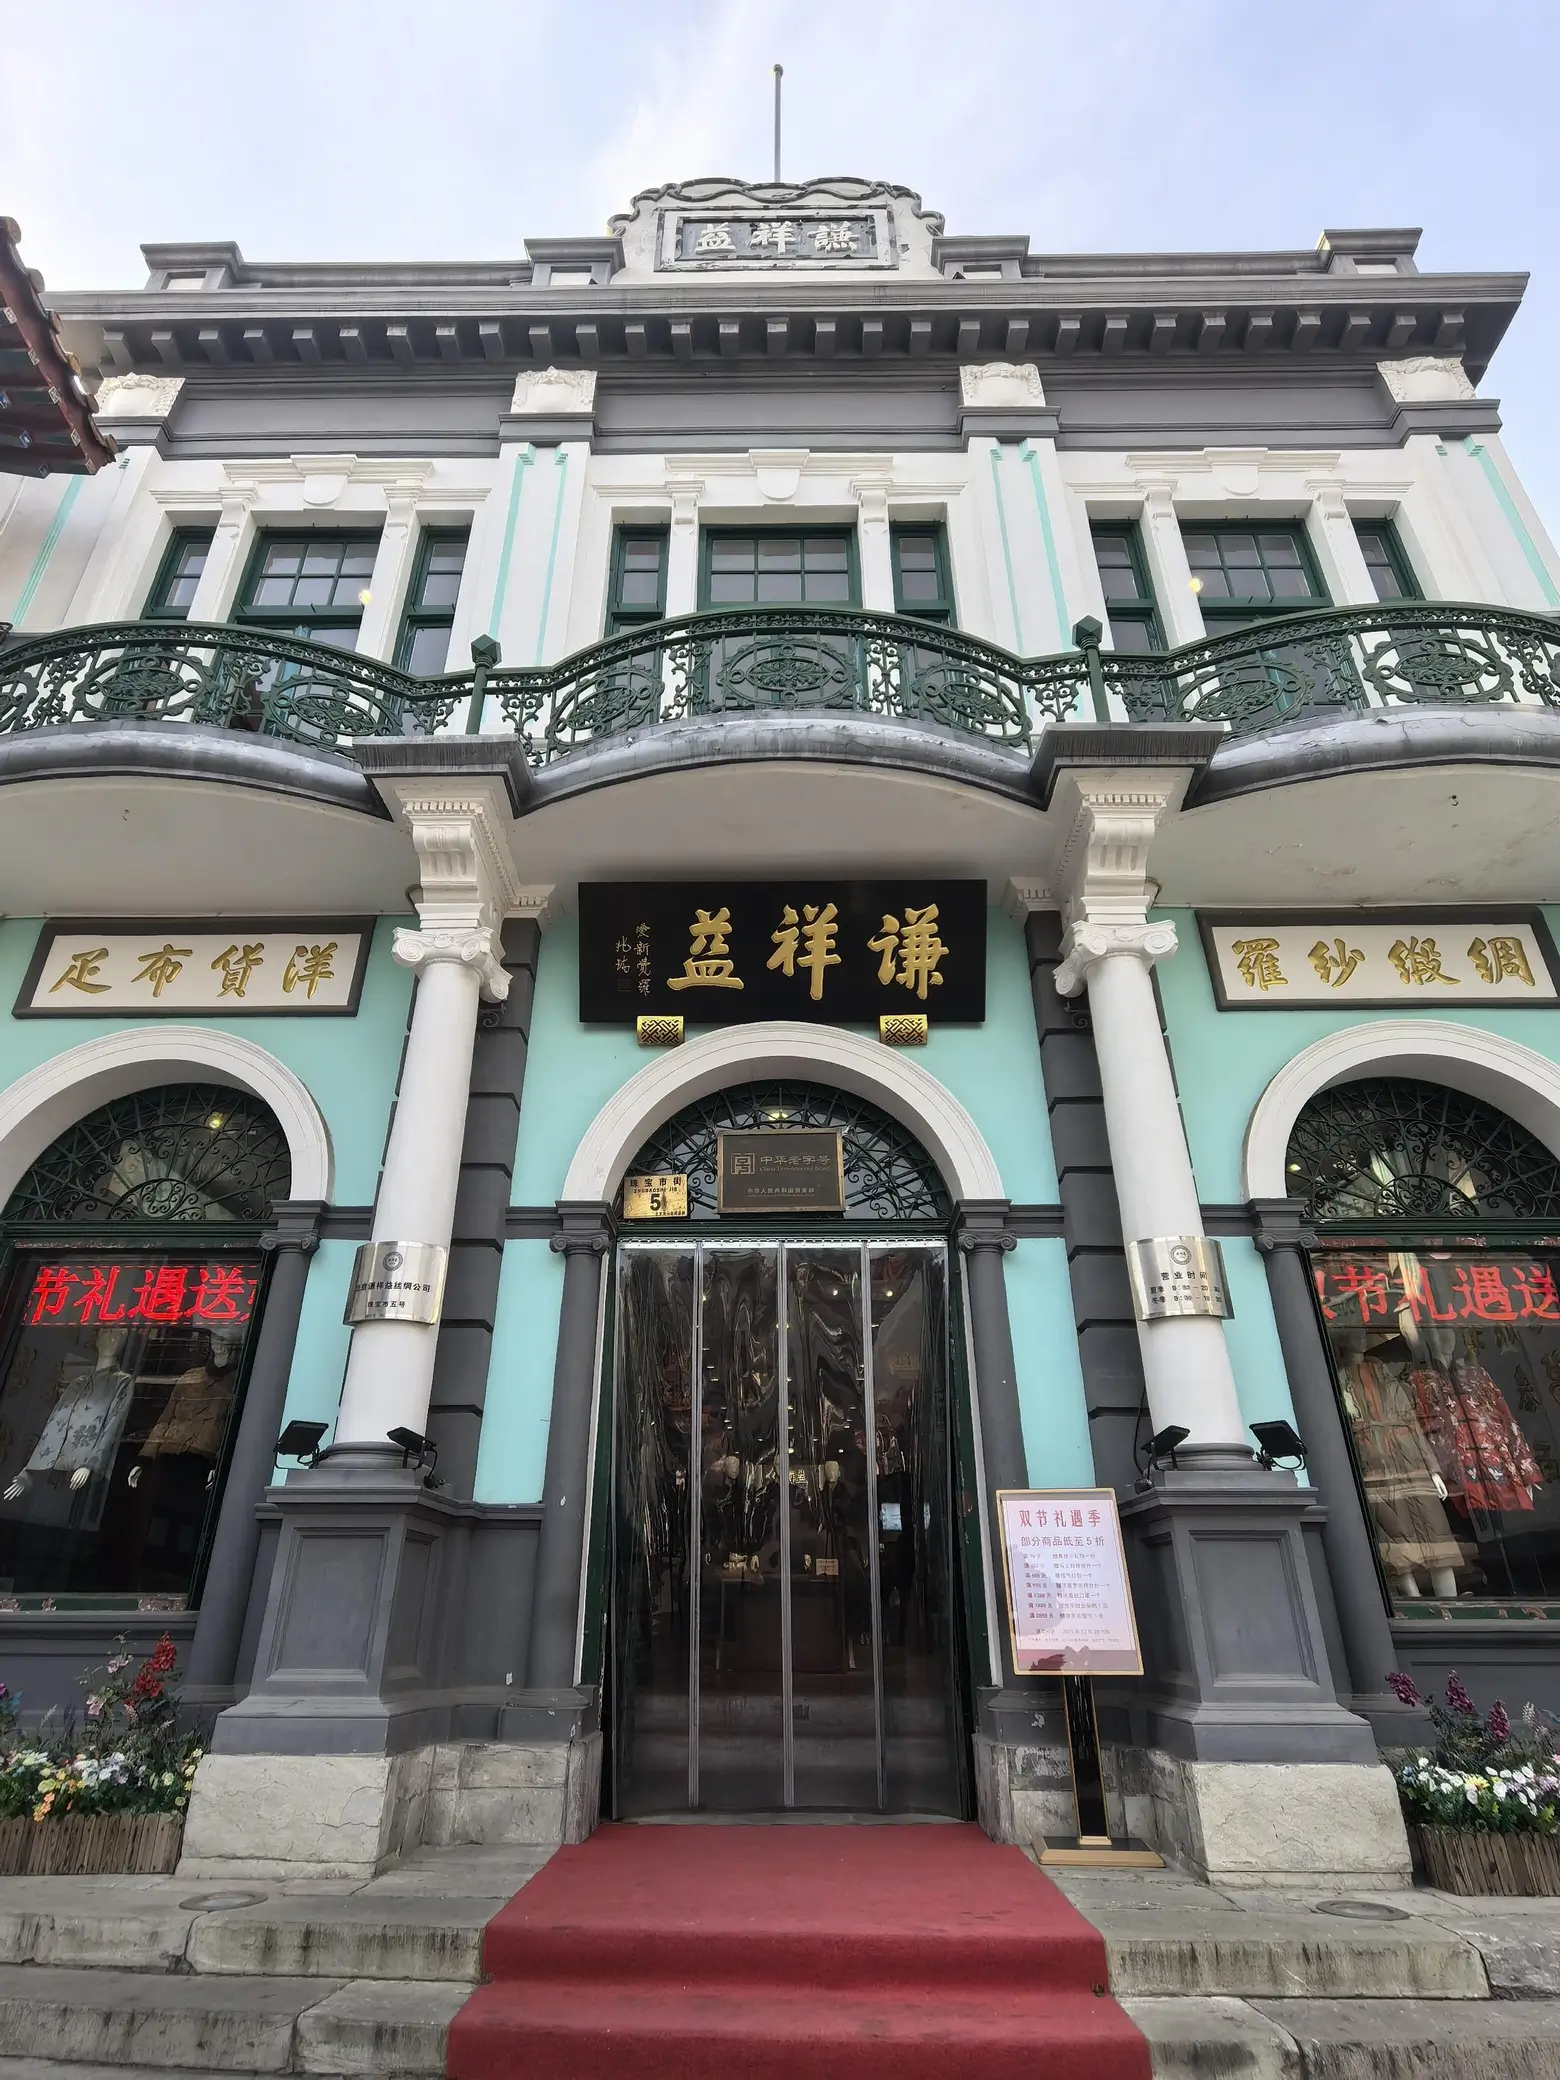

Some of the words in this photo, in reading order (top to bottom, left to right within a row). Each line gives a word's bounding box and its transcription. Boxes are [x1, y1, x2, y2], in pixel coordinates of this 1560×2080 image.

[760, 1154, 830, 1165] 中华老字号
[629, 1176, 682, 1188] 珠宝市街
[650, 1193, 661, 1212] 5
[1160, 1271, 1208, 1281] 营业时间
[1018, 1509, 1101, 1528] 双节礼遇季
